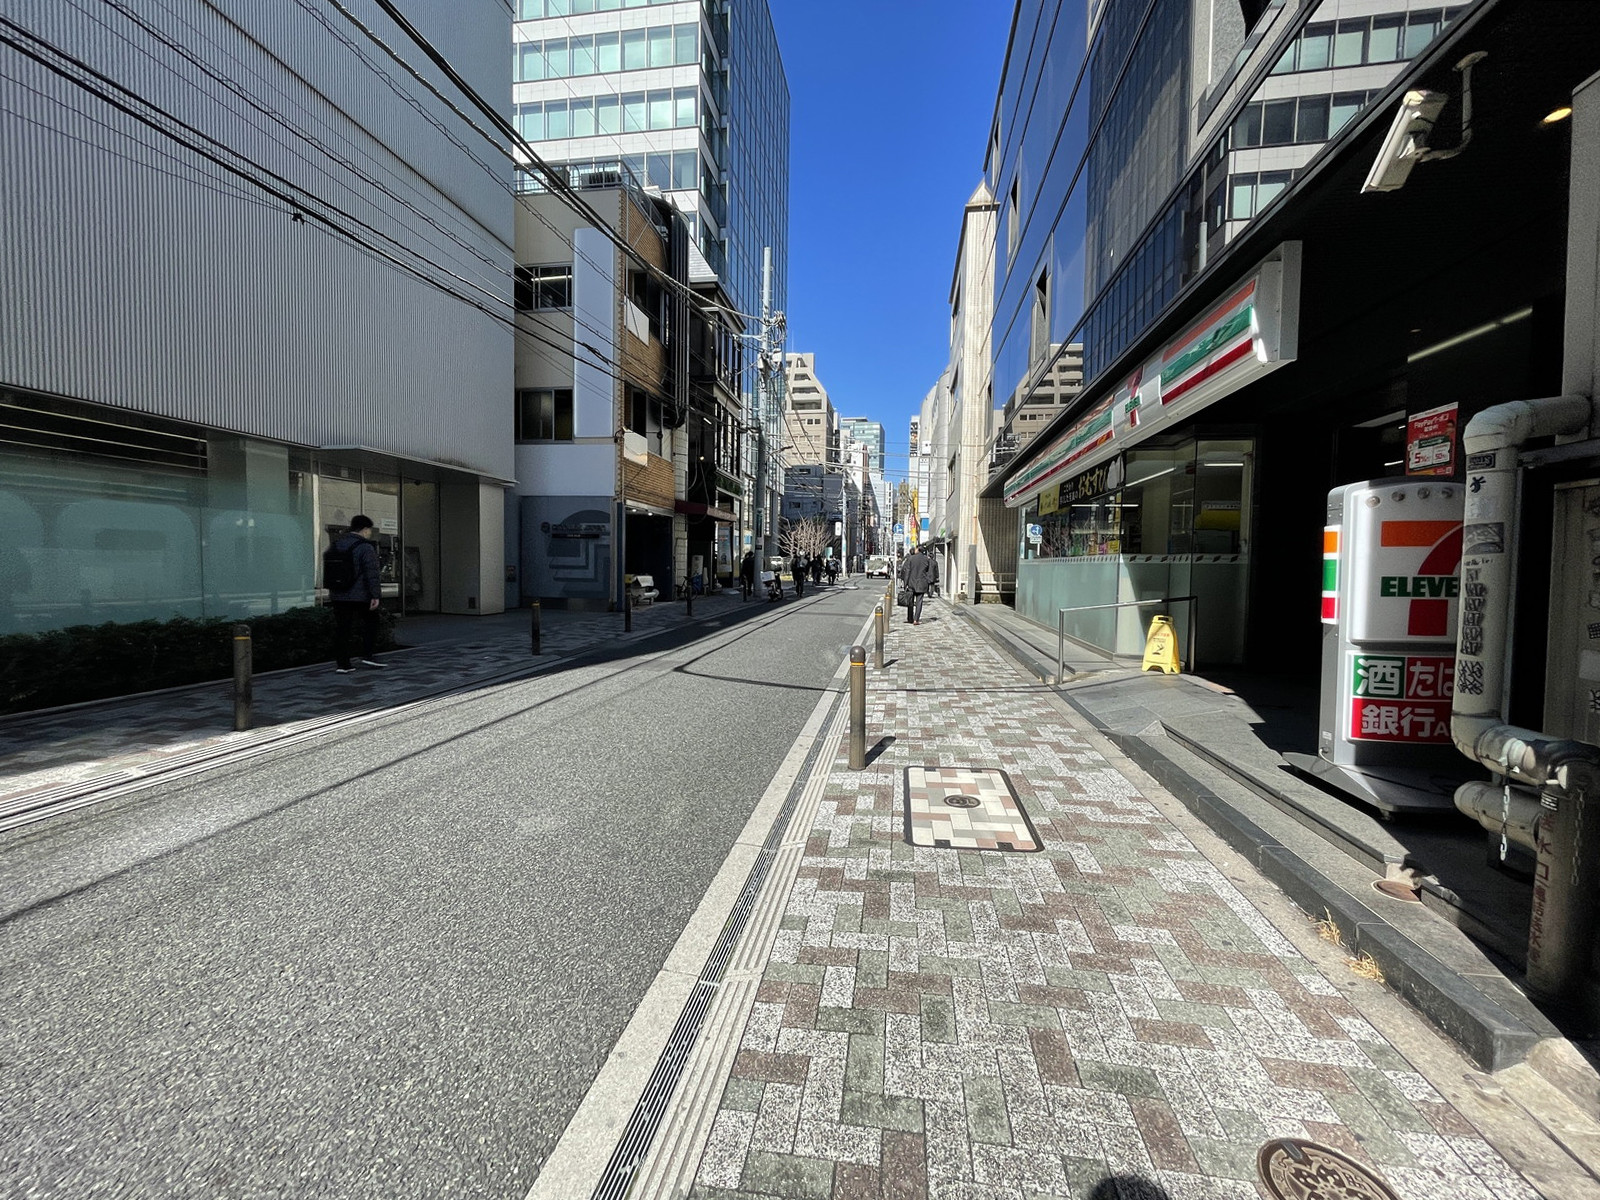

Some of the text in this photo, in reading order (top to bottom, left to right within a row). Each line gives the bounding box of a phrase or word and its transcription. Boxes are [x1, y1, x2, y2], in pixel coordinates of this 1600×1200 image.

[1380, 576, 1461, 598] ELEVE
[1356, 658, 1402, 696] 酒
[1361, 704, 1450, 738] 銀行A
